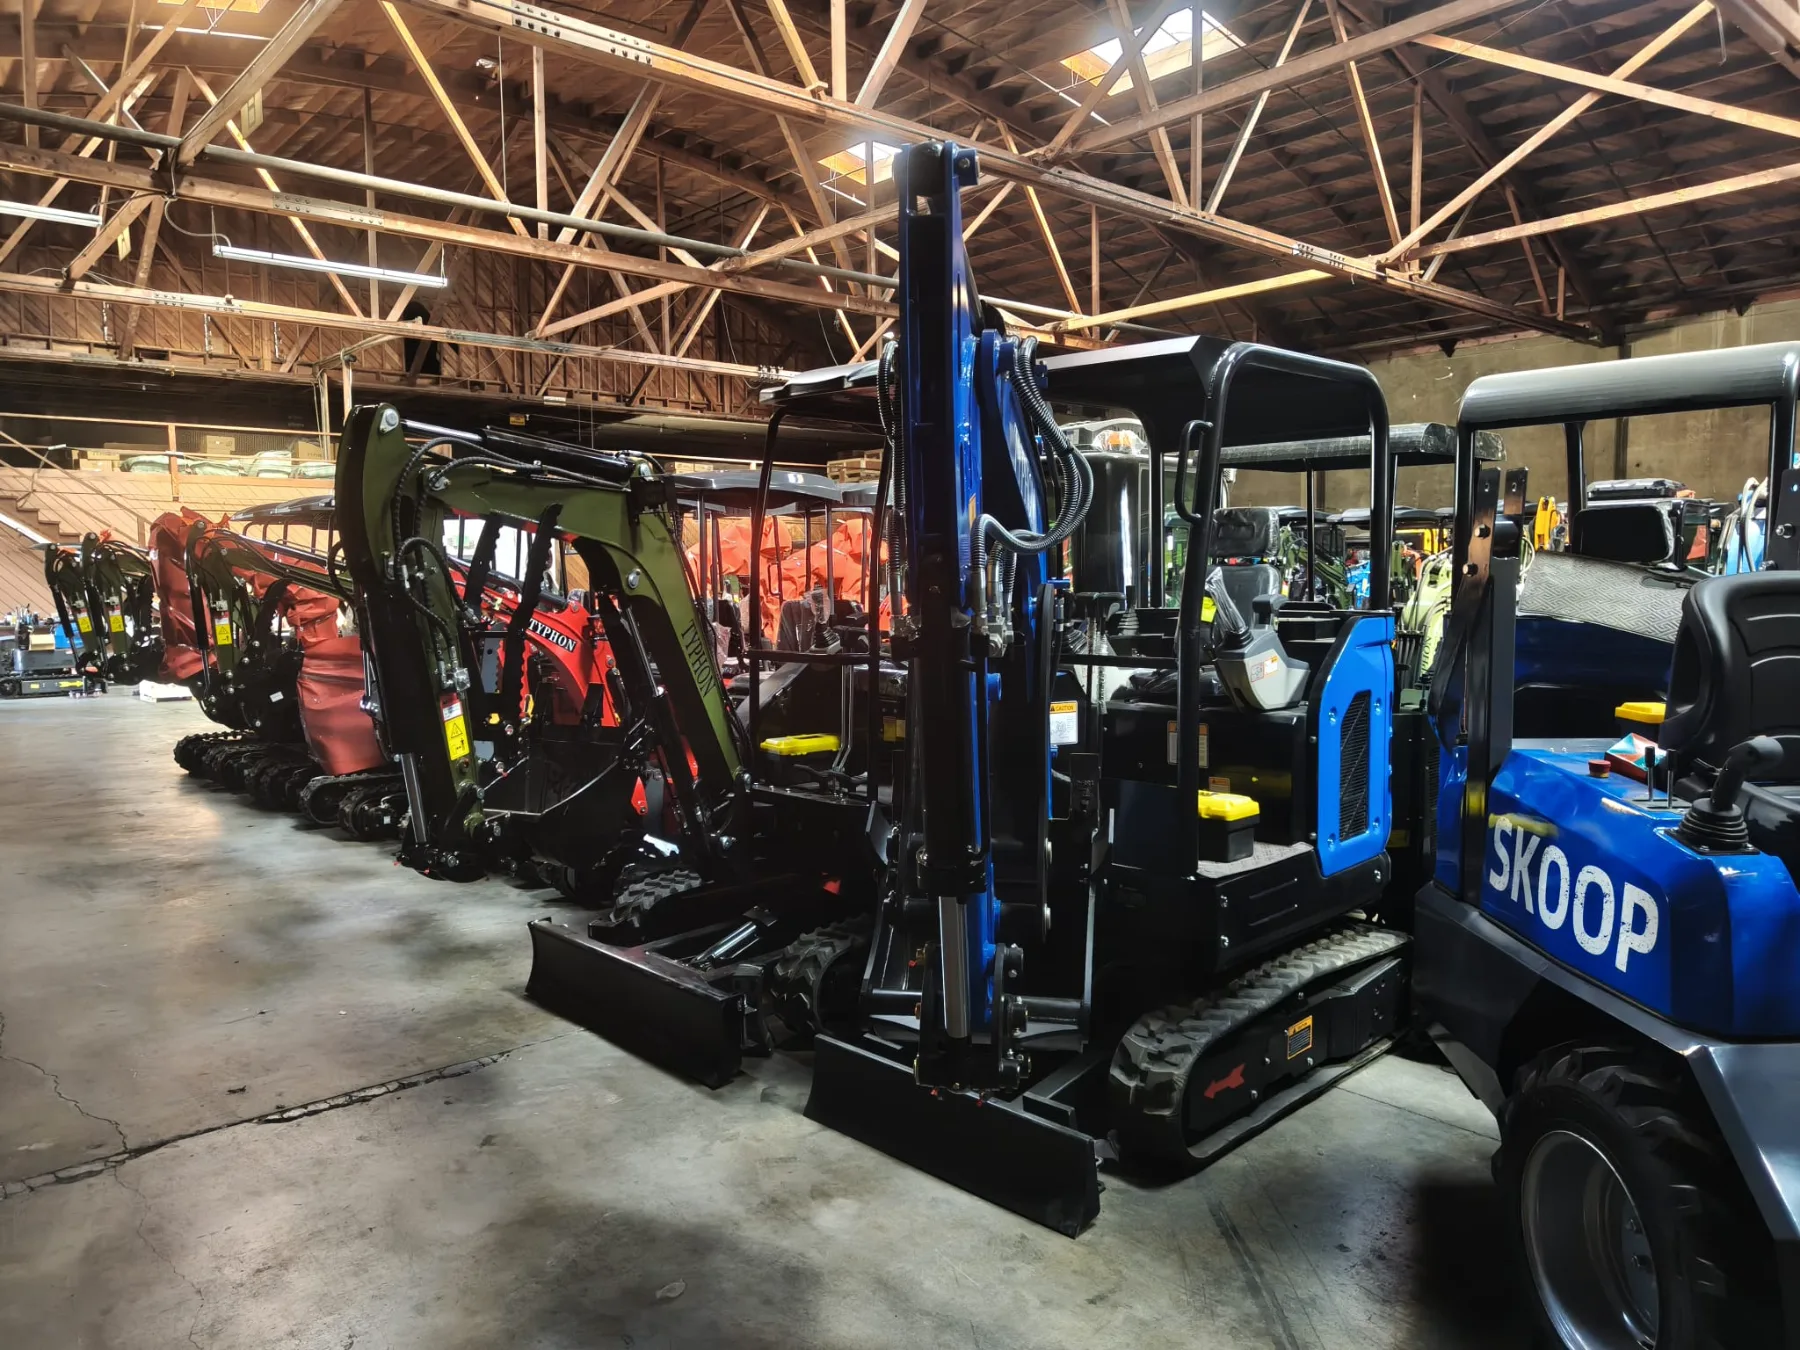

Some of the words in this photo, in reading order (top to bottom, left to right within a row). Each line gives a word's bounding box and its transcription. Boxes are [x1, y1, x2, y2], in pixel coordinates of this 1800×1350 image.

[528, 618, 577, 652] TYPHON
[681, 618, 717, 698] TYPHON
[1489, 817, 1659, 973] SKOOP
